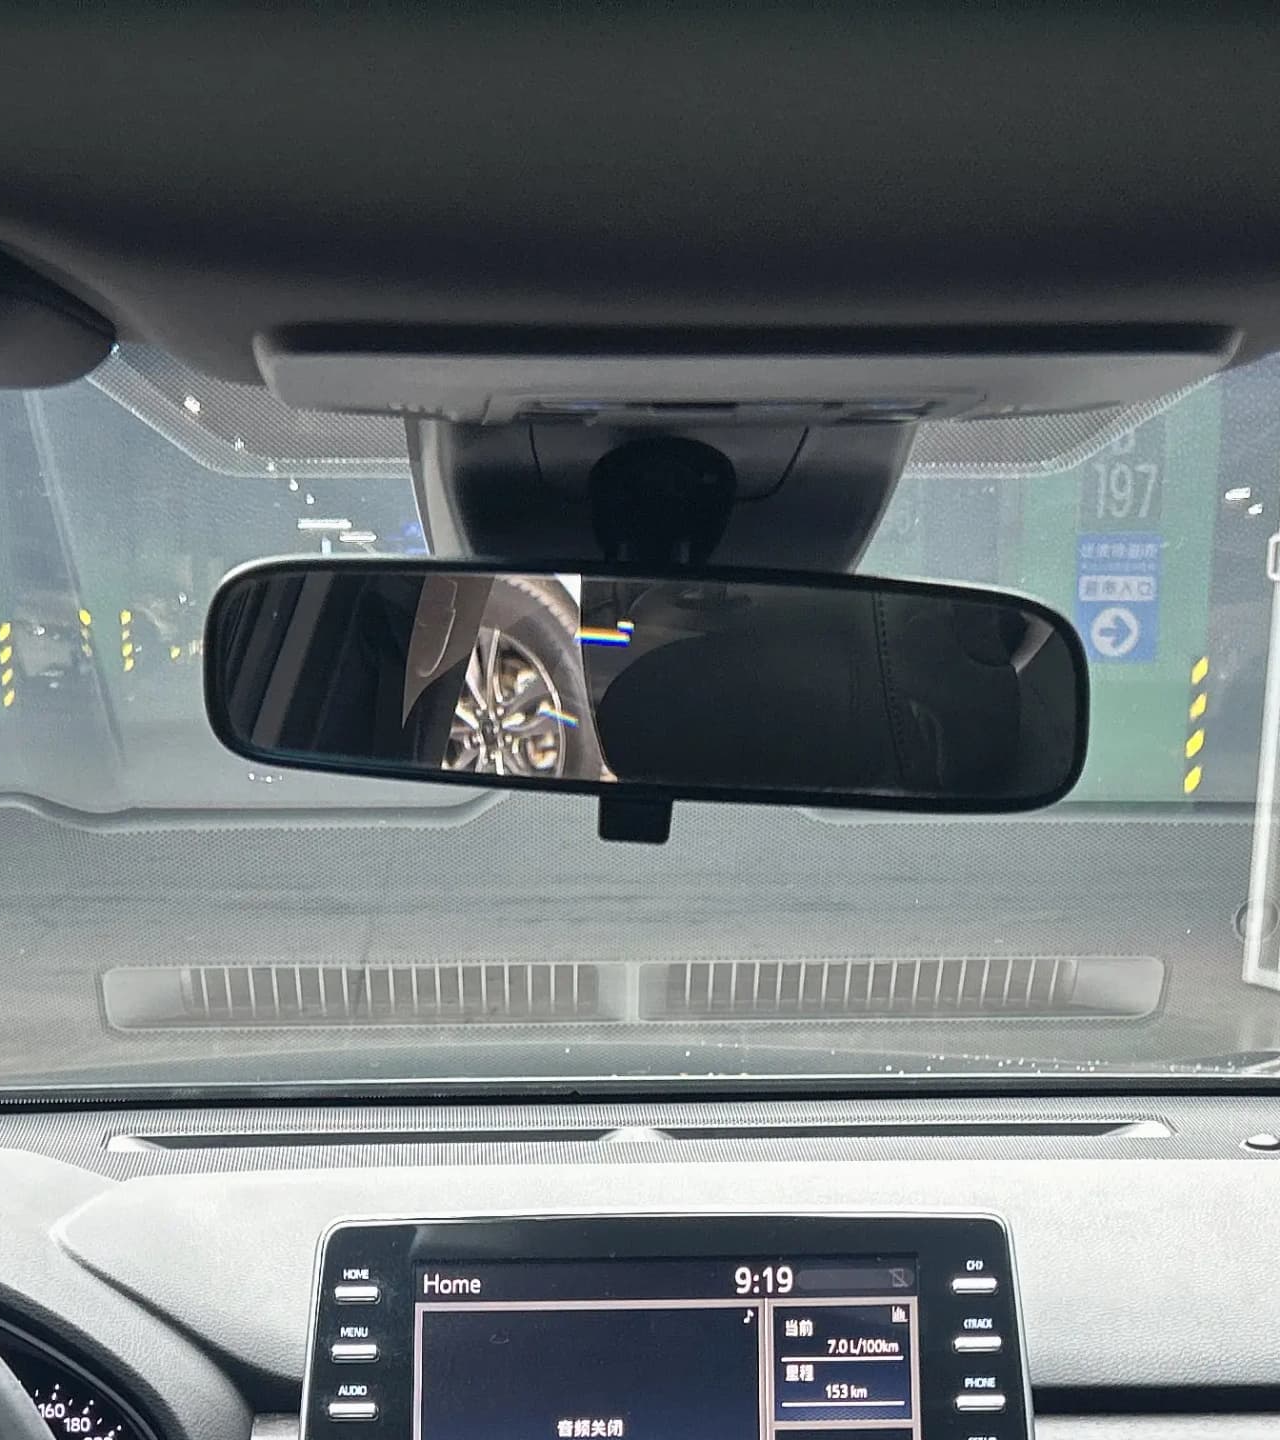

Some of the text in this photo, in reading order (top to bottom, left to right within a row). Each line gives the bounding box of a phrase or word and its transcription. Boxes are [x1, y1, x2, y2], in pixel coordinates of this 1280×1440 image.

[1092, 461, 1160, 520] 197
[343, 1268, 370, 1280] HOME
[734, 1266, 794, 1294] 9:19
[423, 1273, 481, 1294] Home
[340, 1327, 368, 1338] MENU
[785, 1319, 814, 1337] 当前
[827, 1339, 849, 1354] 7.0
[964, 1377, 996, 1388] PHONE
[338, 1385, 368, 1396] AUDIO
[825, 1384, 868, 1399] 153 km
[38, 1403, 66, 1419] 160
[64, 1417, 91, 1432] 180
[557, 1419, 623, 1438] 音频关闭
